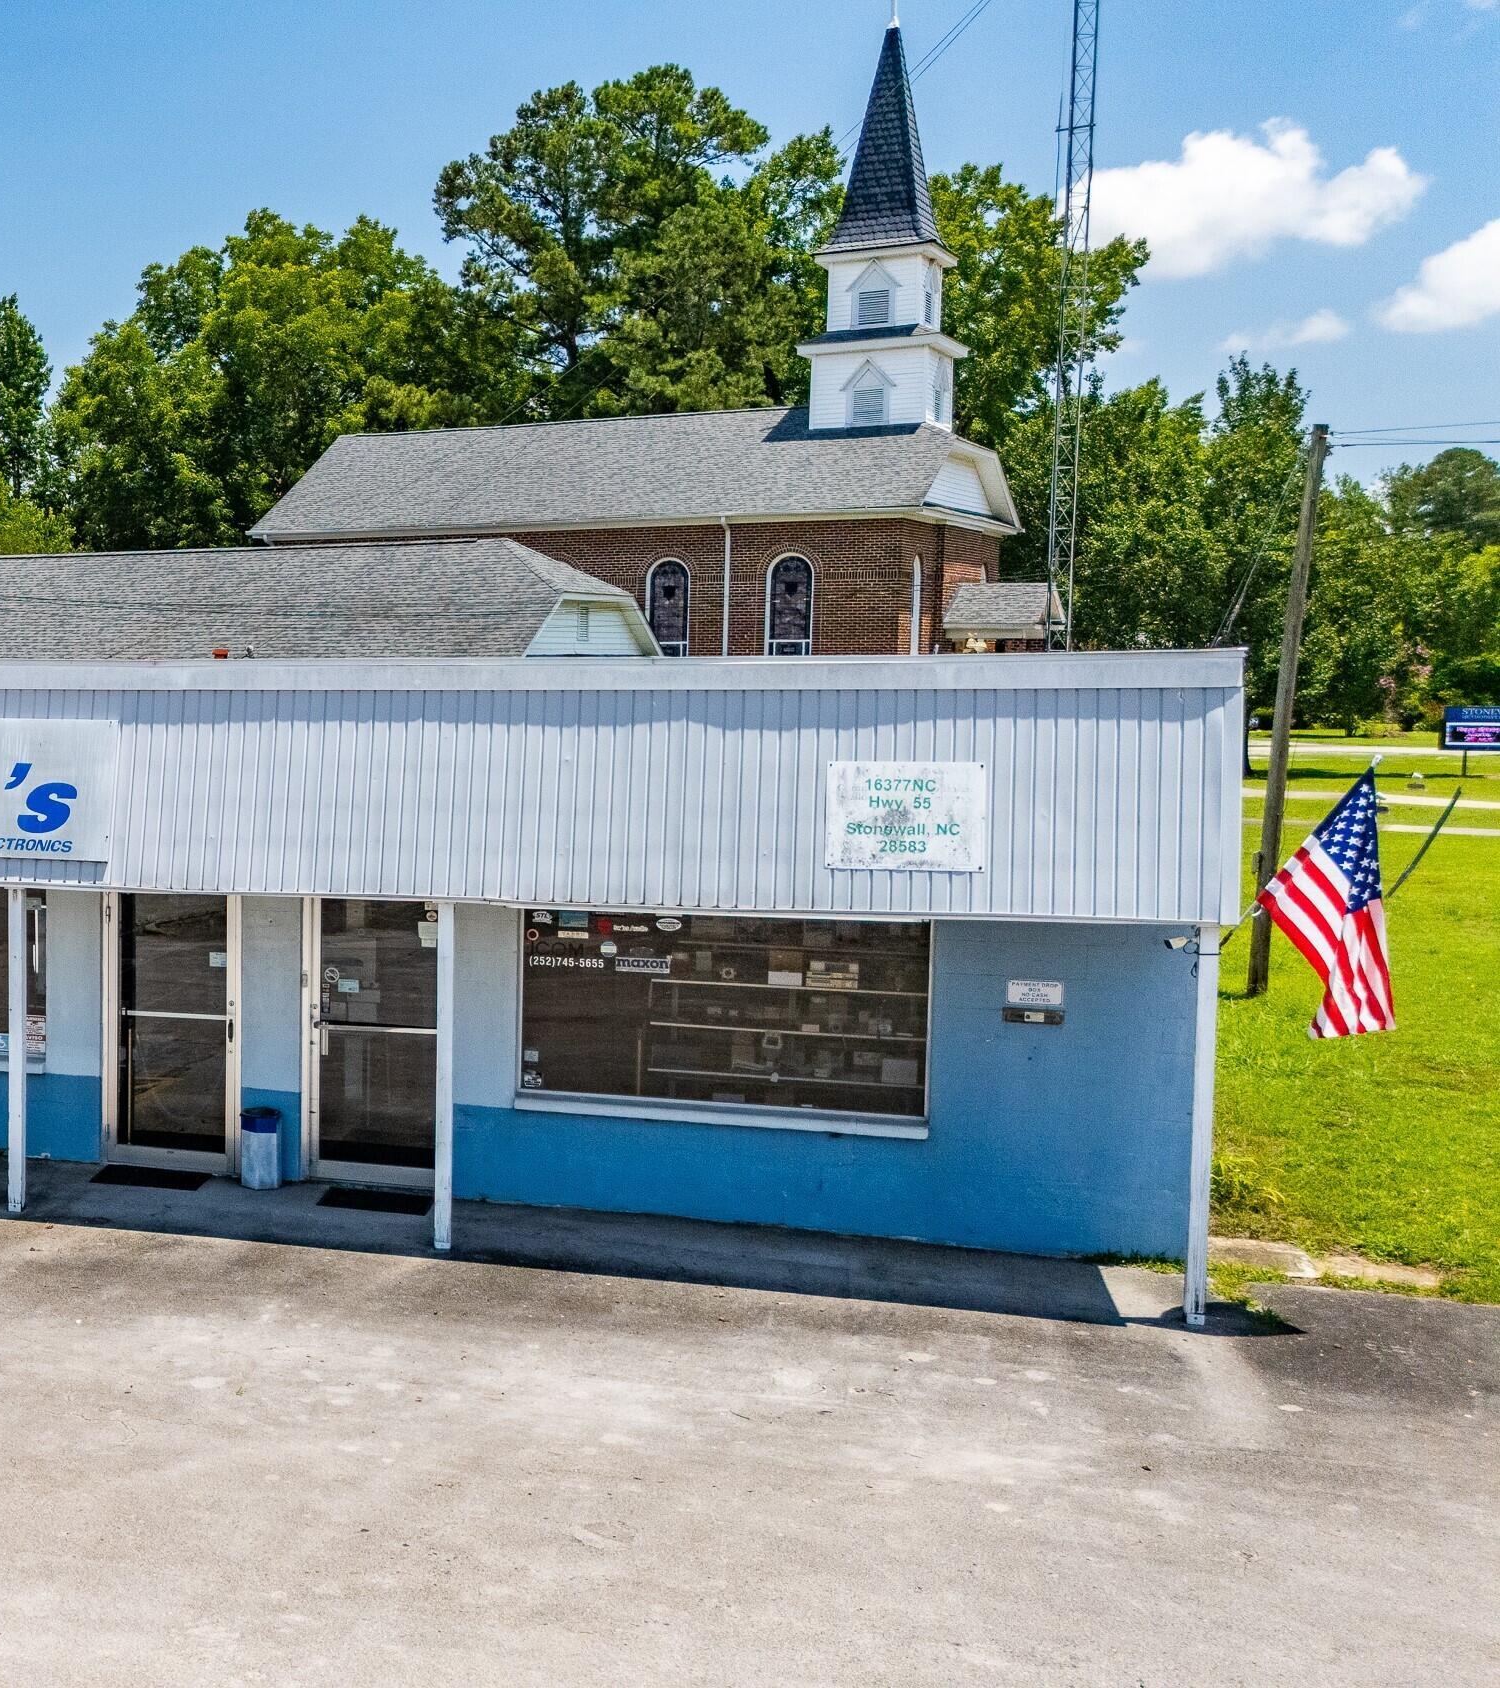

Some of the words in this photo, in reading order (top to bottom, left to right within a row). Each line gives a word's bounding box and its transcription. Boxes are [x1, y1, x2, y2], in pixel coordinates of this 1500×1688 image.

[865, 779, 937, 793] 16377NC
[869, 796, 904, 811] Hwy
[913, 797, 931, 809] 55
[845, 822, 930, 837] Stonewall,
[936, 824, 961, 836] NC
[878, 840, 927, 853] 28583
[529, 956, 604, 969] (252)745-5655
[617, 958, 669, 970] maxon
